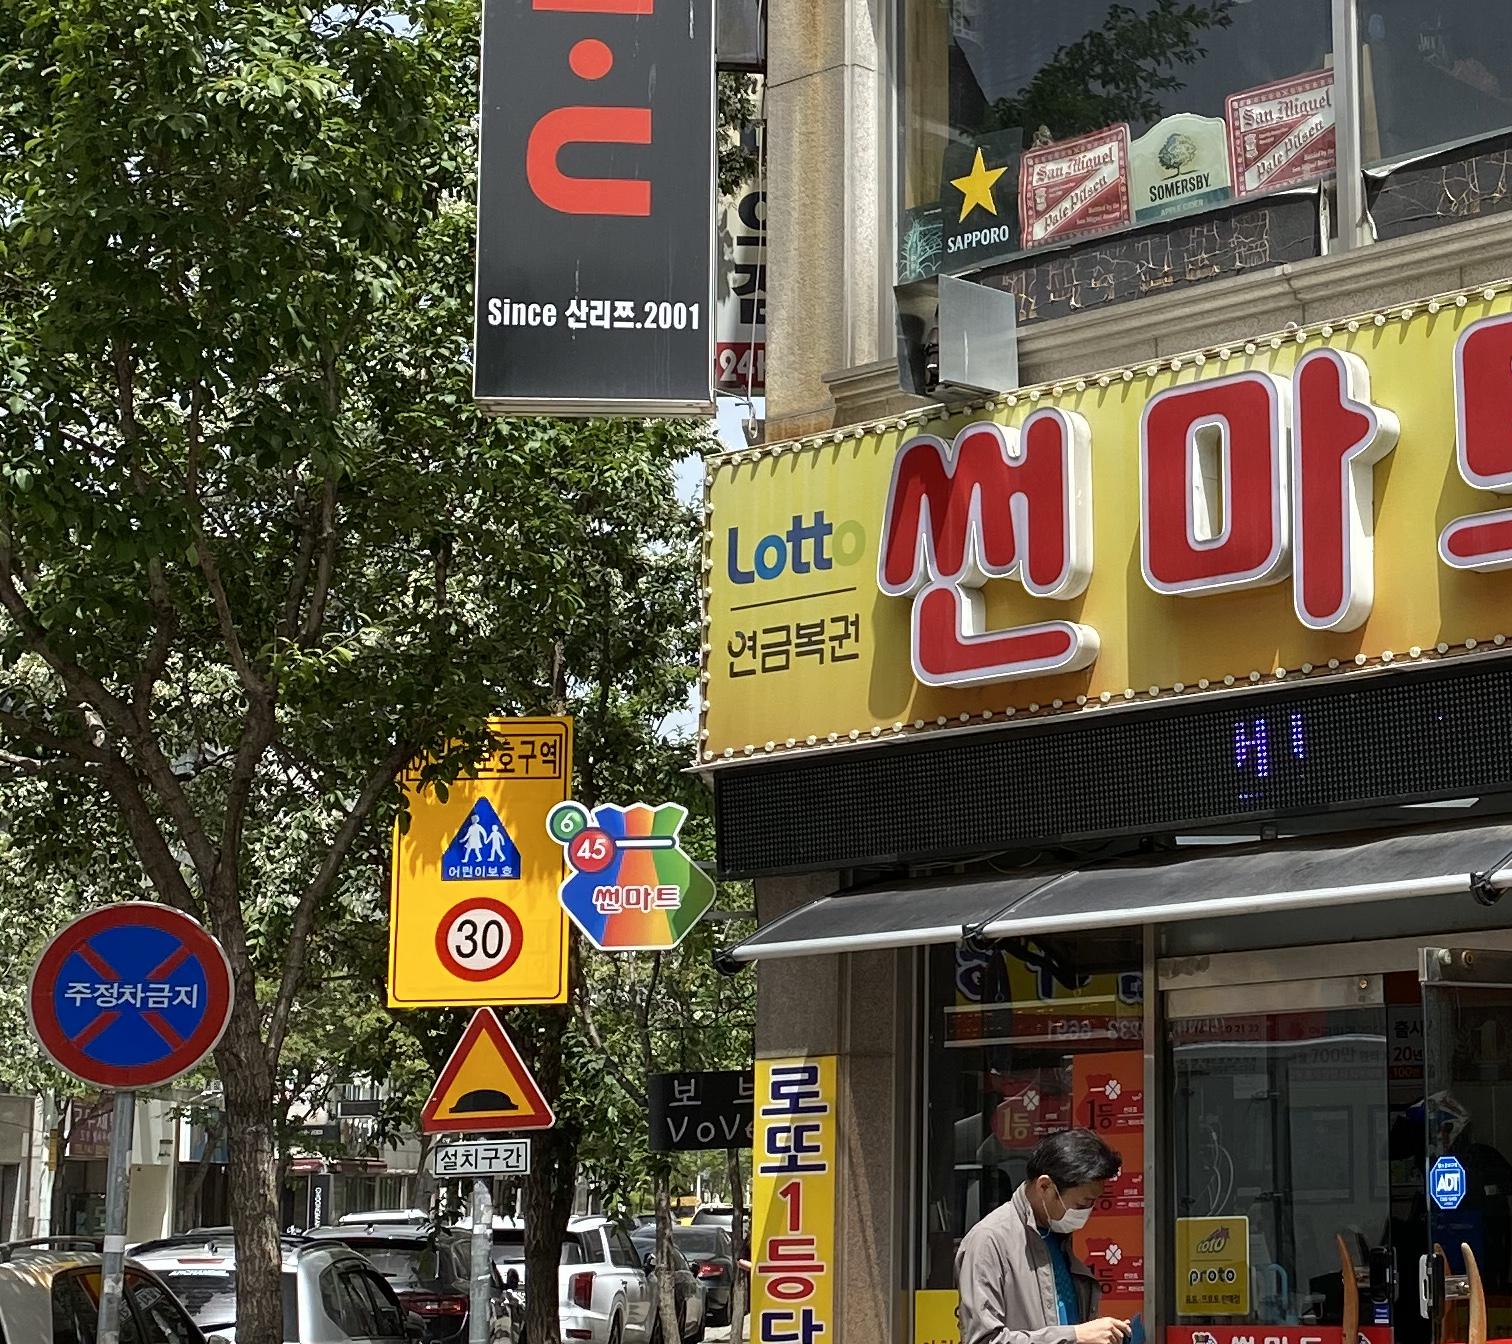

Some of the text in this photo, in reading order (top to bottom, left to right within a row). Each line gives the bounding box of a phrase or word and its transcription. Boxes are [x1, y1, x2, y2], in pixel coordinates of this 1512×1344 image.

[1242, 108, 1274, 127] San
[1035, 165, 1064, 184] San
[946, 224, 1010, 254] SAPPORO
[487, 298, 557, 327] Since
[727, 509, 866, 585] Lotto
[726, 613, 861, 679] 연금복권
[560, 812, 577, 833] 6
[576, 838, 607, 860] 45
[448, 865, 513, 878] 어린이보호
[592, 884, 682, 914] 썬마트
[455, 918, 504, 959] 30
[64, 980, 198, 1011] 주정차금지
[440, 1146, 522, 1171] 설치구간
[1436, 1172, 1460, 1192] ADT
[1188, 1266, 1237, 1287] proto
